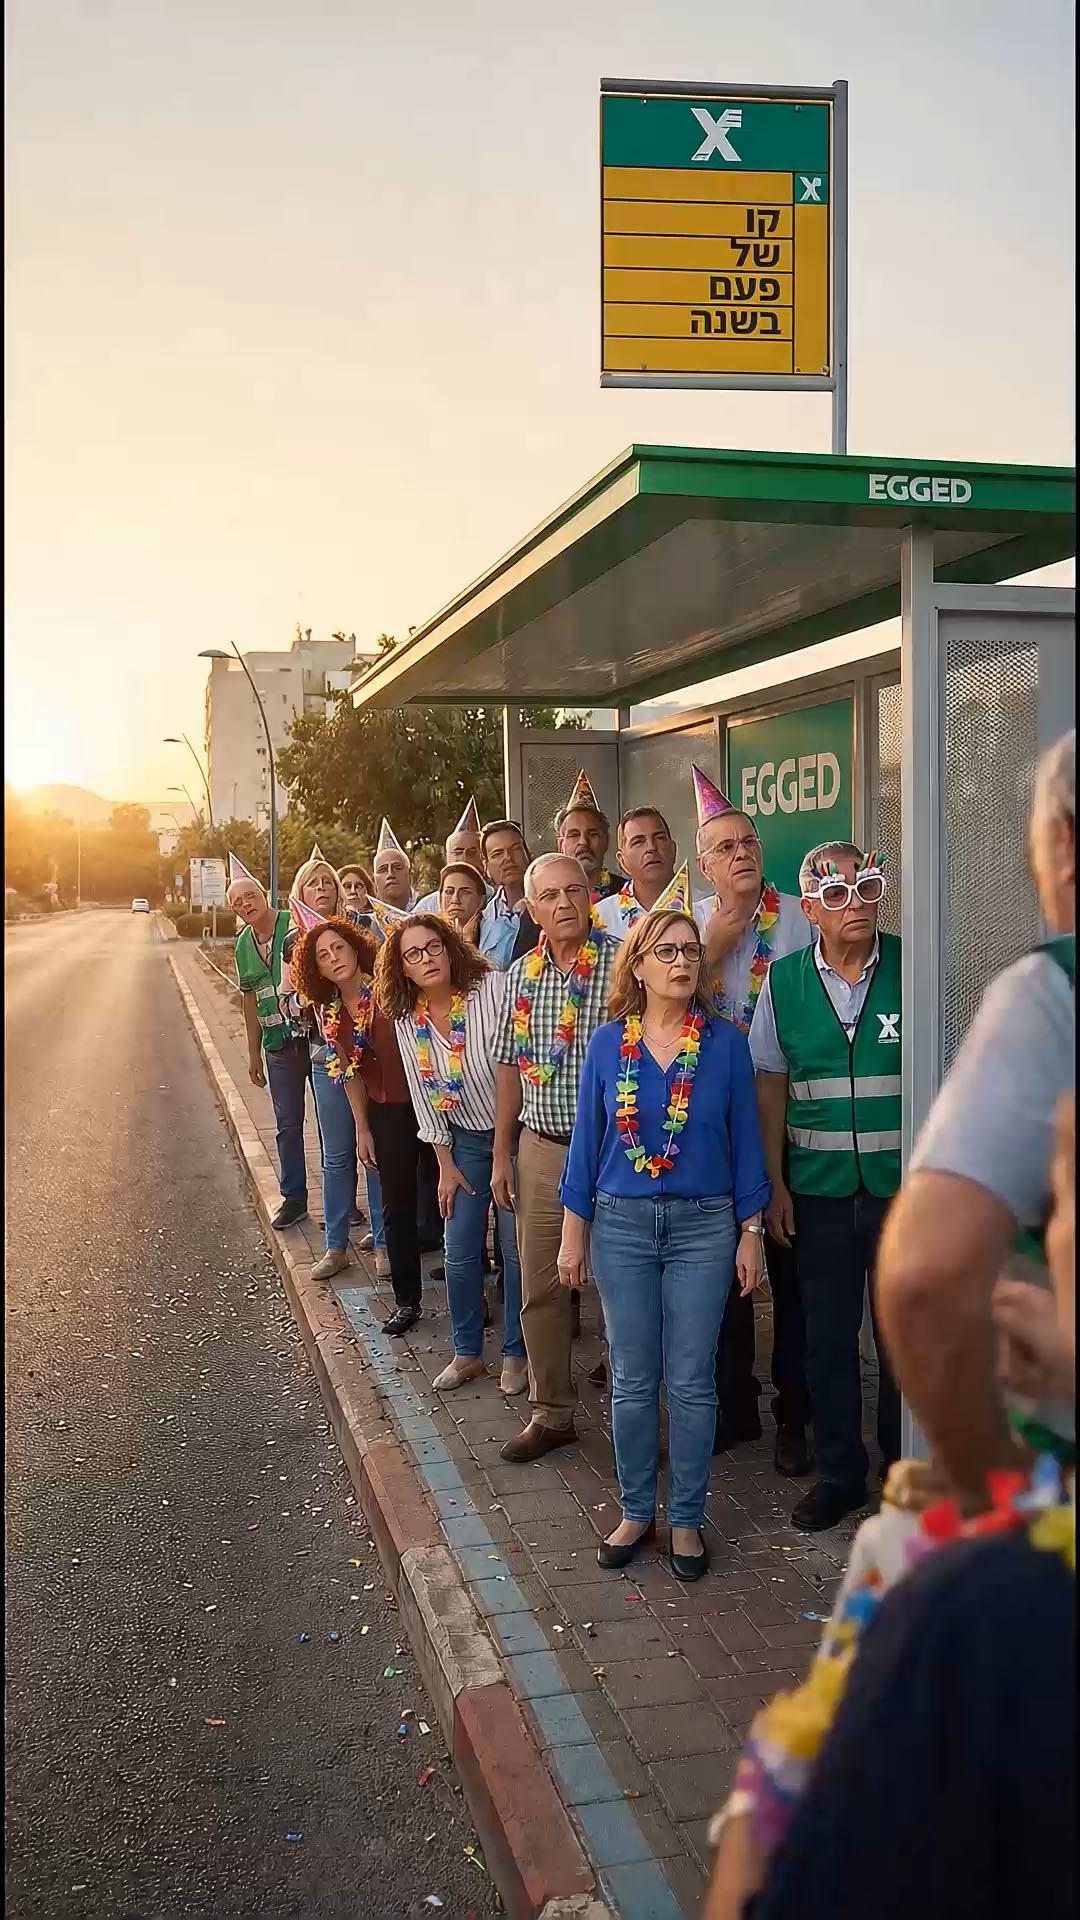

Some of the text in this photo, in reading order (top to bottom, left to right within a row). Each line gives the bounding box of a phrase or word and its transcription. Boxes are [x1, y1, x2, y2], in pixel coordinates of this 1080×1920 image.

[746, 208, 780, 237] קו
[730, 237, 780, 267] של
[709, 275, 780, 301] פעם
[690, 309, 781, 335] בשנה
[868, 473, 972, 503] EGGED
[741, 752, 841, 817] EGGED
